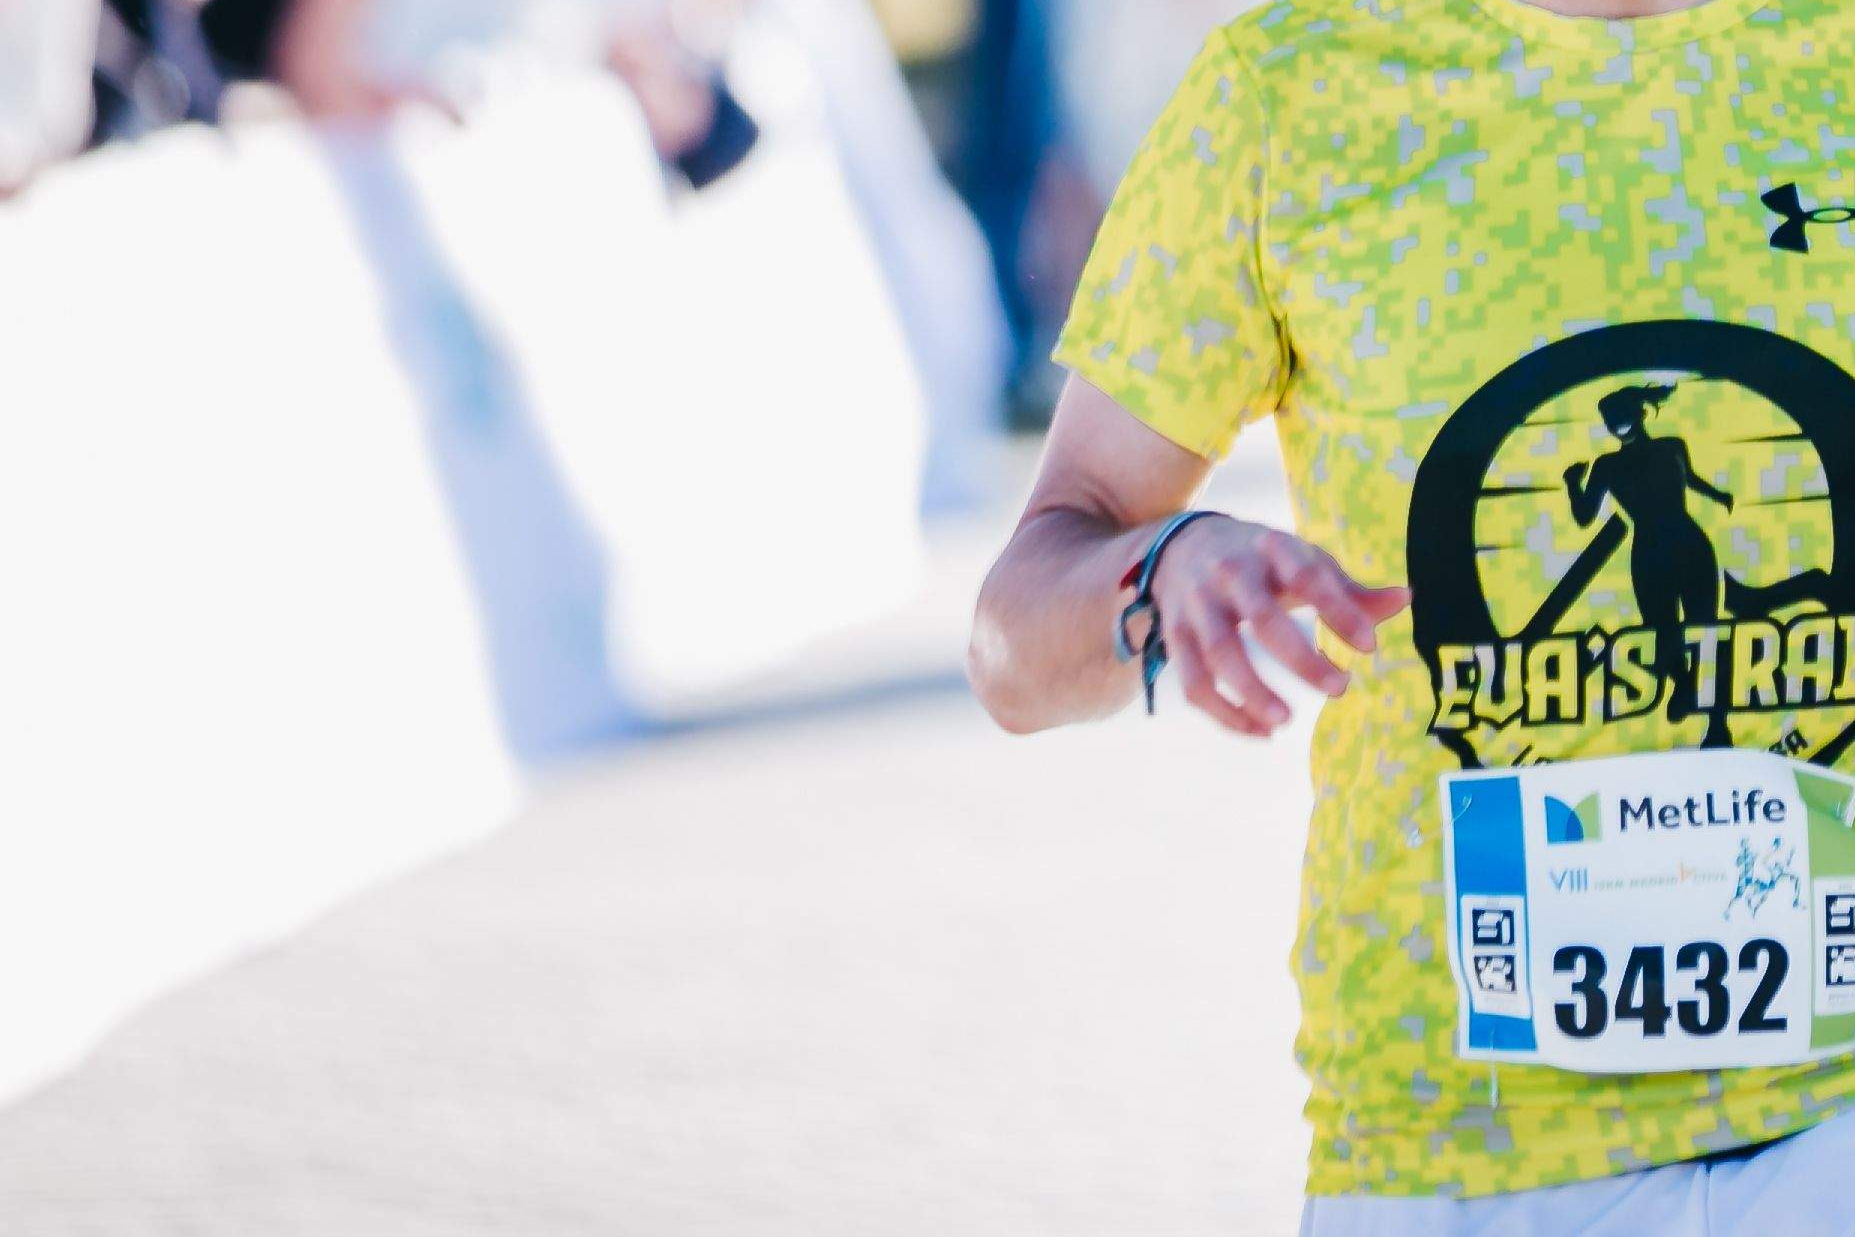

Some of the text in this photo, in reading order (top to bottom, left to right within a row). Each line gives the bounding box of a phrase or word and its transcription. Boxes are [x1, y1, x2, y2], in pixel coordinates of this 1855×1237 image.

[1618, 789, 1787, 833] MetLife
[1548, 867, 1589, 893] VIII
[1552, 938, 1790, 1040] 3432
